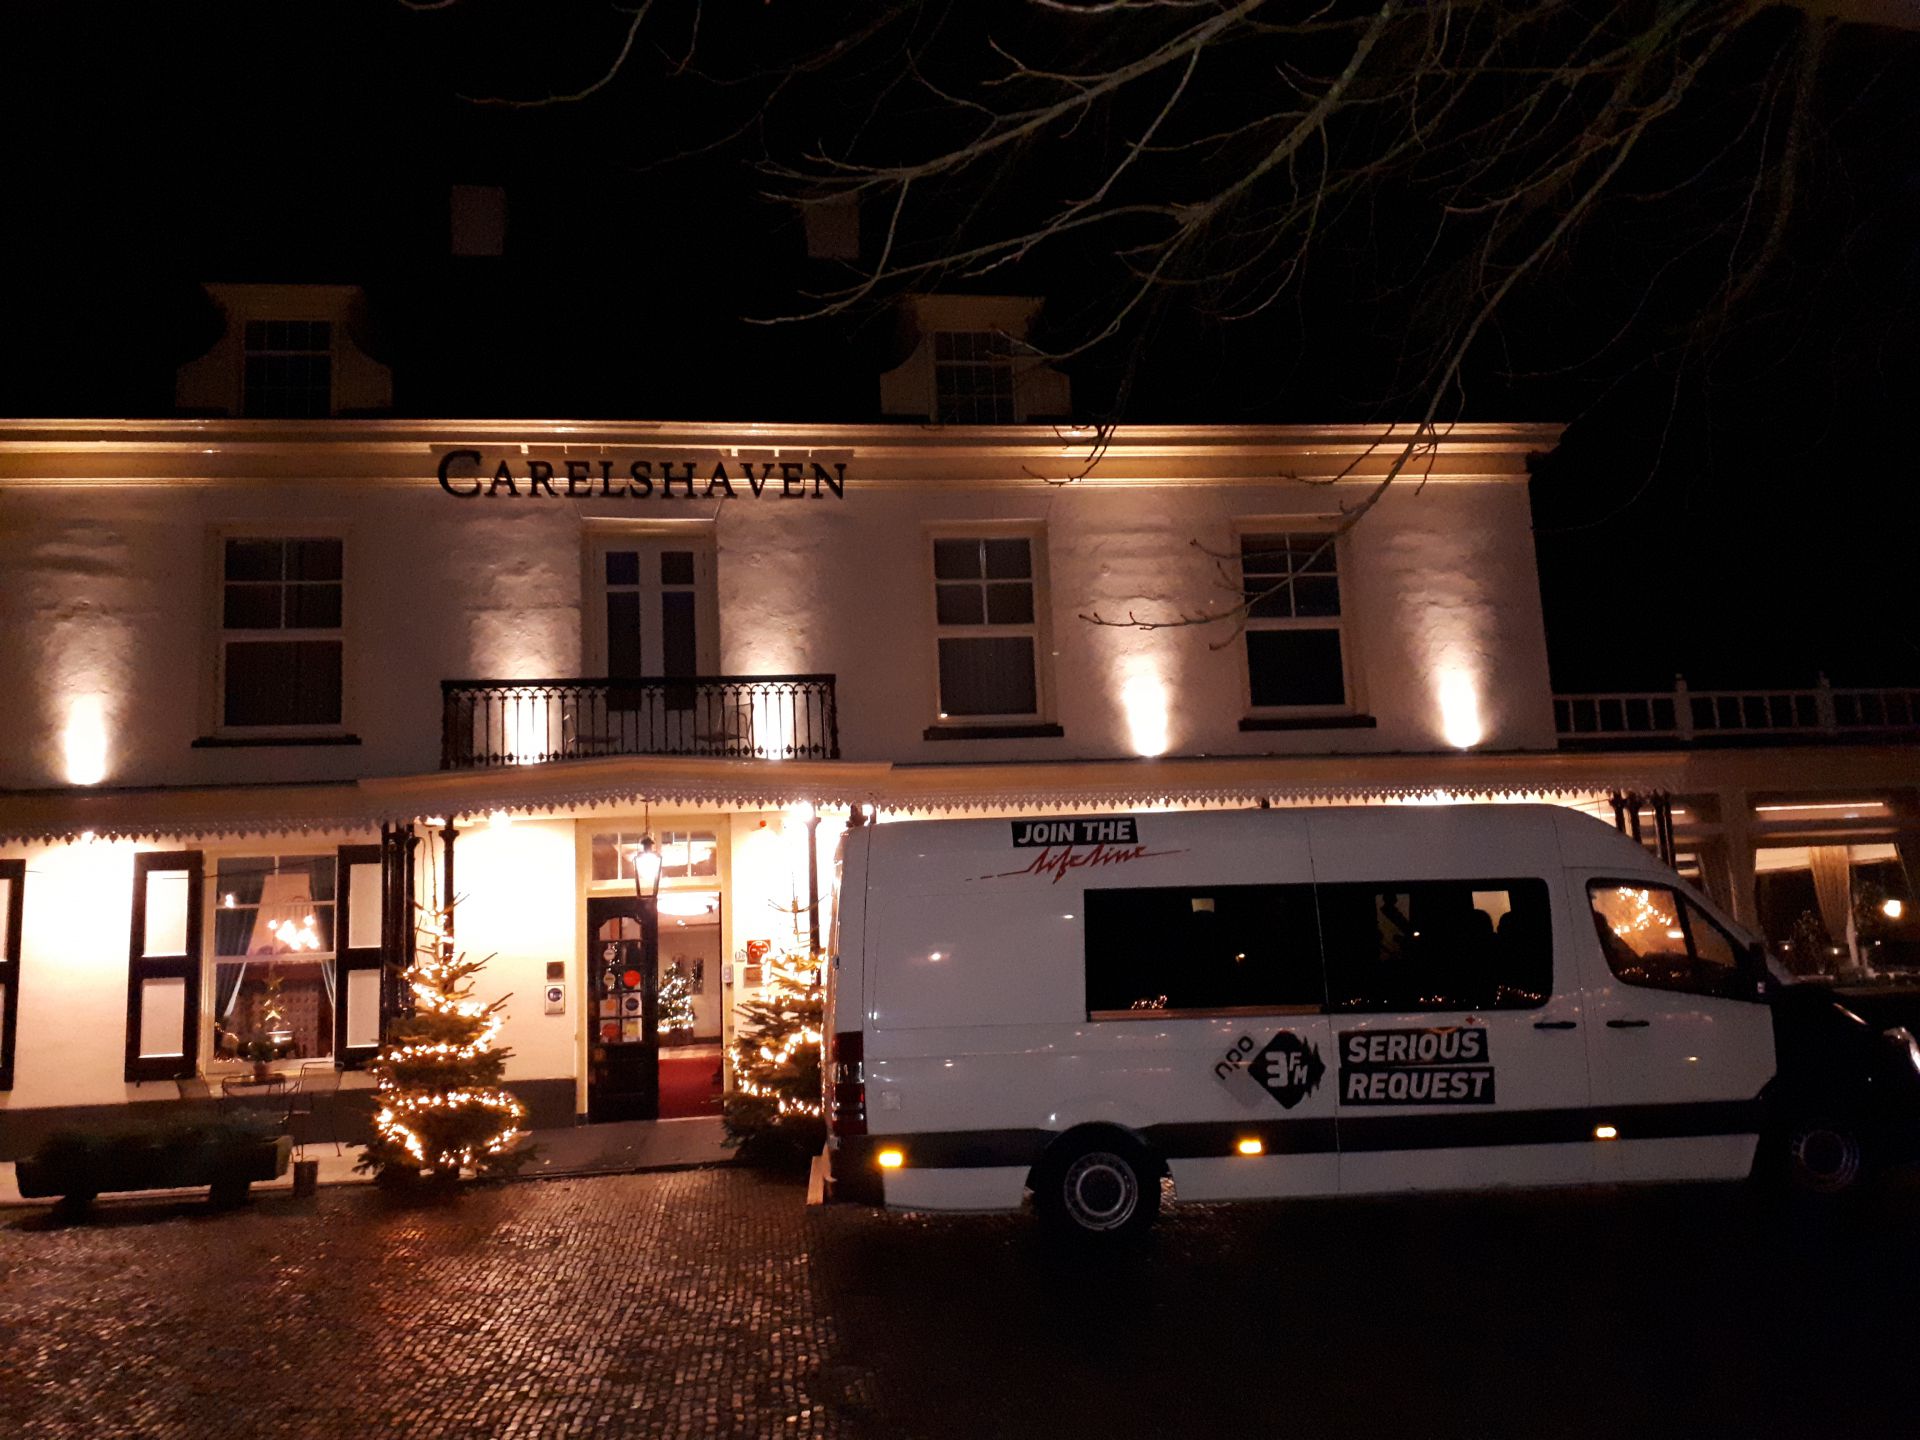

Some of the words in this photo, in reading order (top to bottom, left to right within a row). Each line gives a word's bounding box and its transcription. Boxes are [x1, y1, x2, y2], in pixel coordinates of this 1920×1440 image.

[437, 450, 847, 499] CARELSHAVEN
[1017, 821, 1076, 844] JOIN
[1082, 820, 1131, 841] THE
[1215, 1036, 1254, 1080] npo
[1347, 1032, 1480, 1063] SERIOUS
[1347, 1071, 1490, 1100] REQUEST
